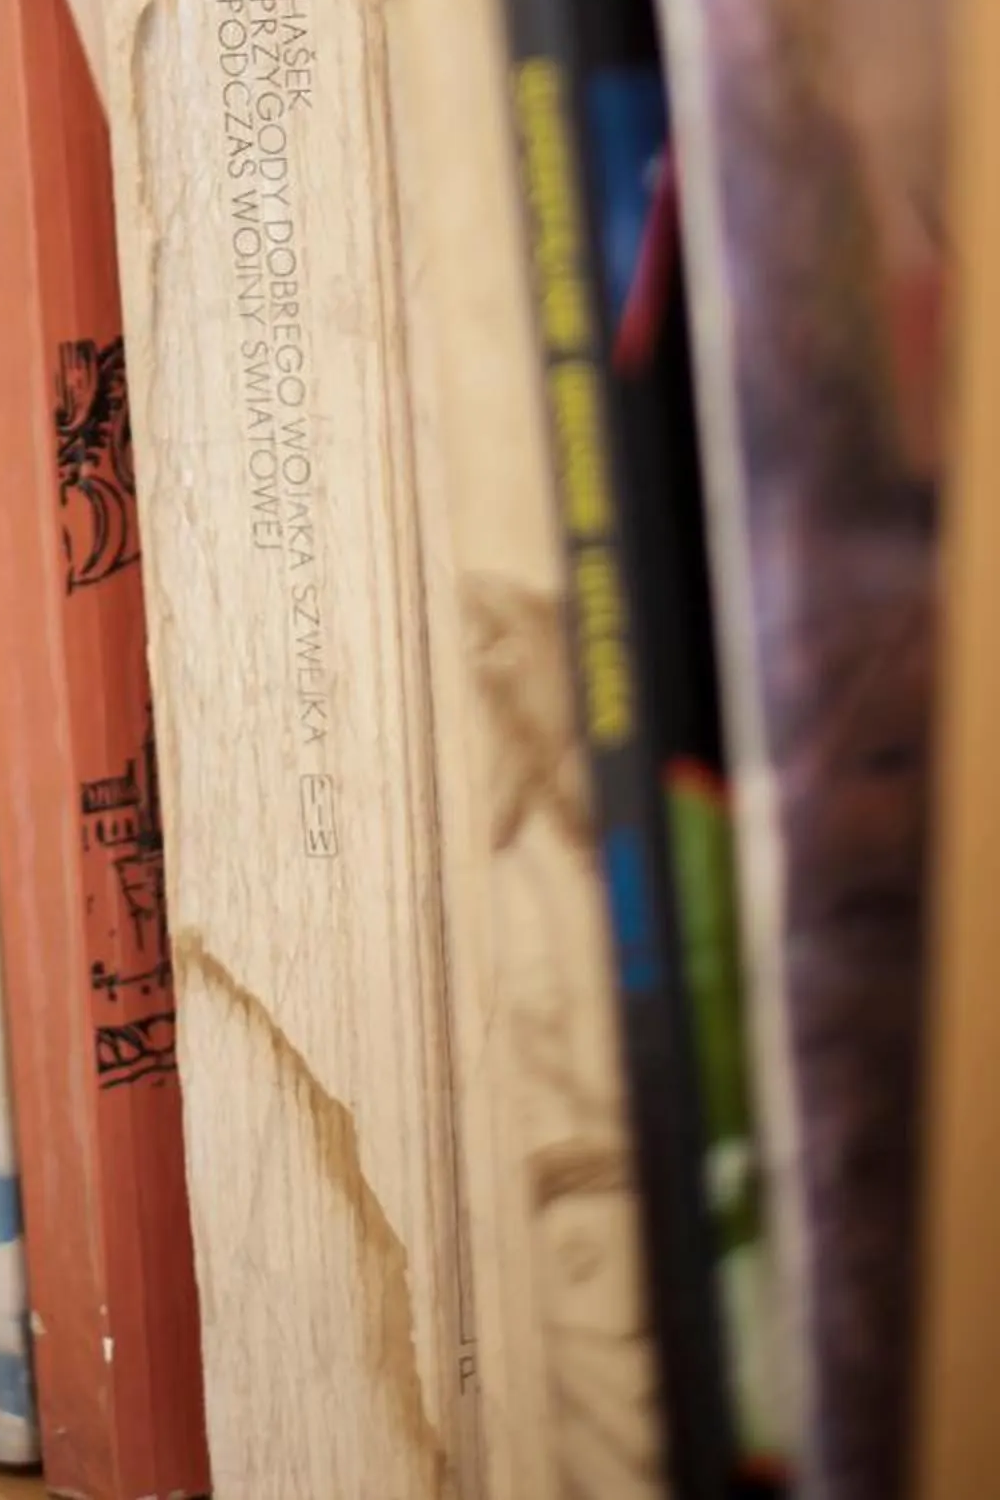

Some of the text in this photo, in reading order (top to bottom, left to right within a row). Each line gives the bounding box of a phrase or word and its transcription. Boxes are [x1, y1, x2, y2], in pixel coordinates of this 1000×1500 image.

[231, 188, 267, 327] WOJNY
[263, 219, 306, 407] DOBREGO
[281, 416, 316, 571] WOJAKA
[291, 582, 329, 745] SZWEJKA
